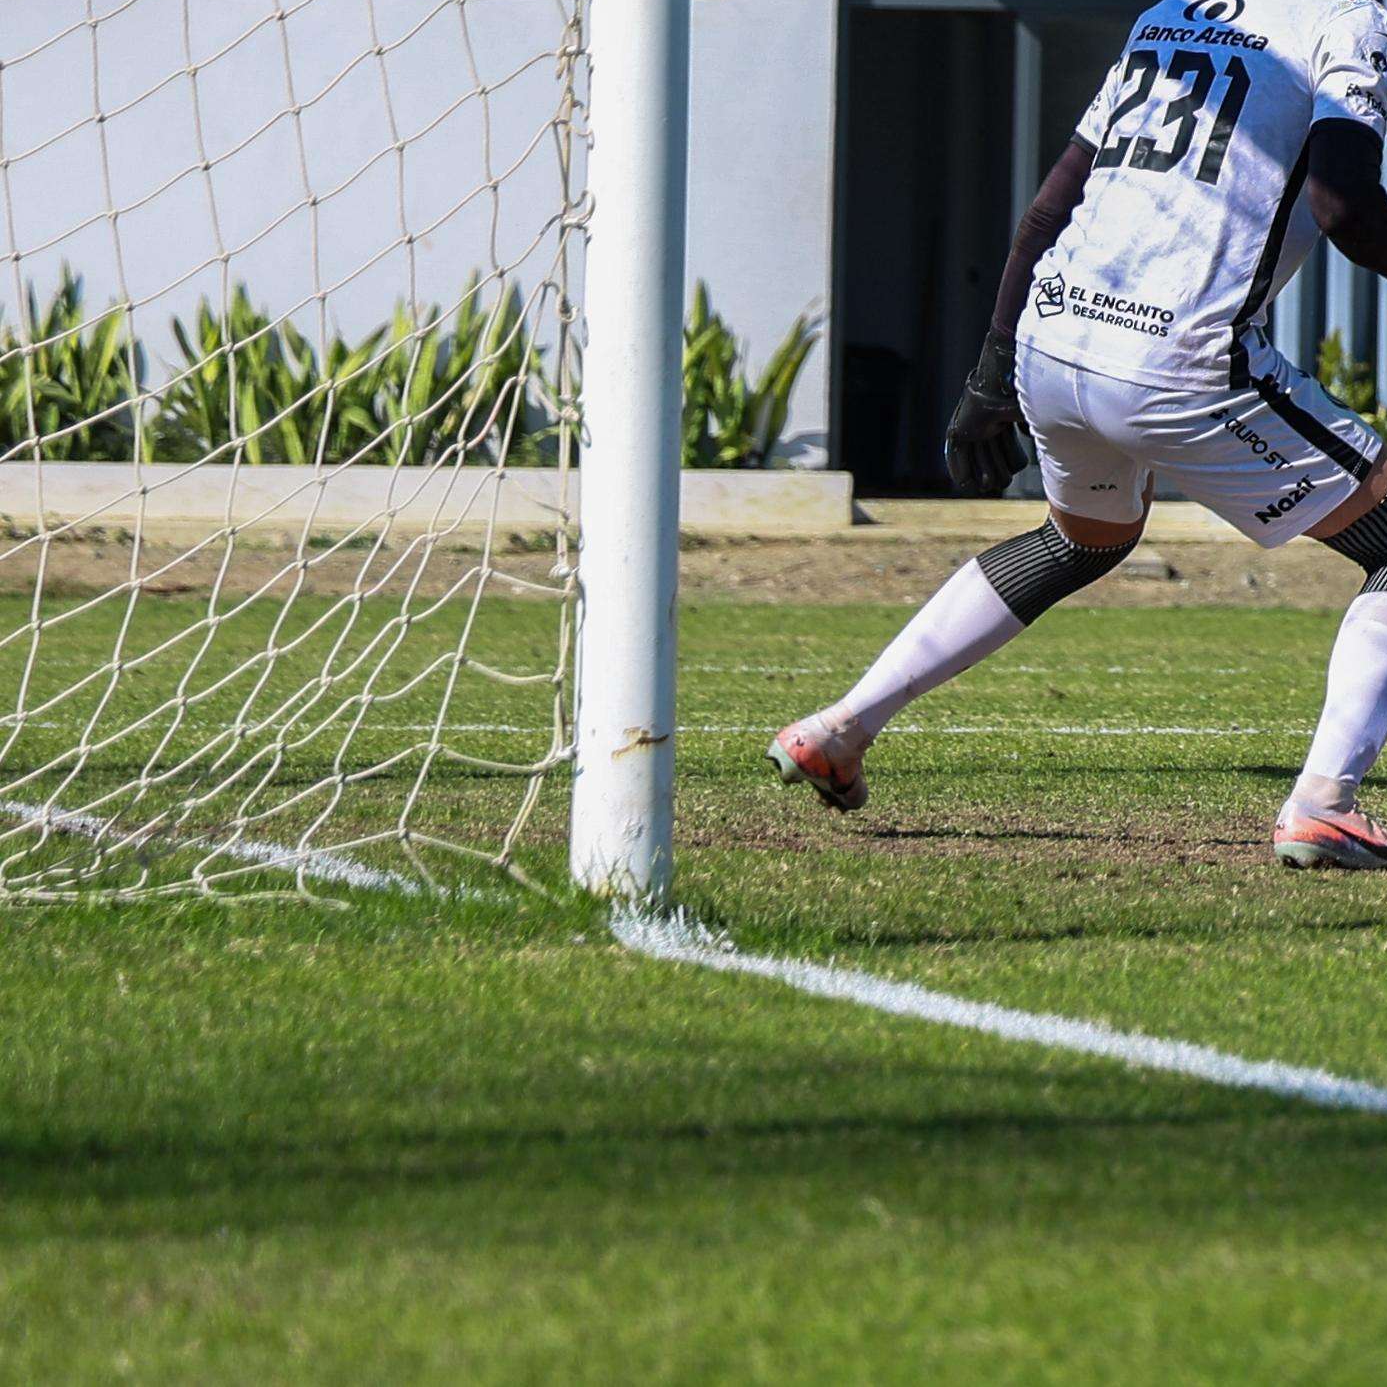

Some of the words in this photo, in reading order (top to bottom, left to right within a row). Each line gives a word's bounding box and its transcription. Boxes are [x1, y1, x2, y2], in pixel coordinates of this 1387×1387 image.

[1199, 28, 1268, 52] Azteca
[1092, 49, 1253, 186] 231
[1069, 286, 1089, 302] EL
[1092, 293, 1175, 324] ENCANTO
[1072, 305, 1170, 338] DESARROLLOS
